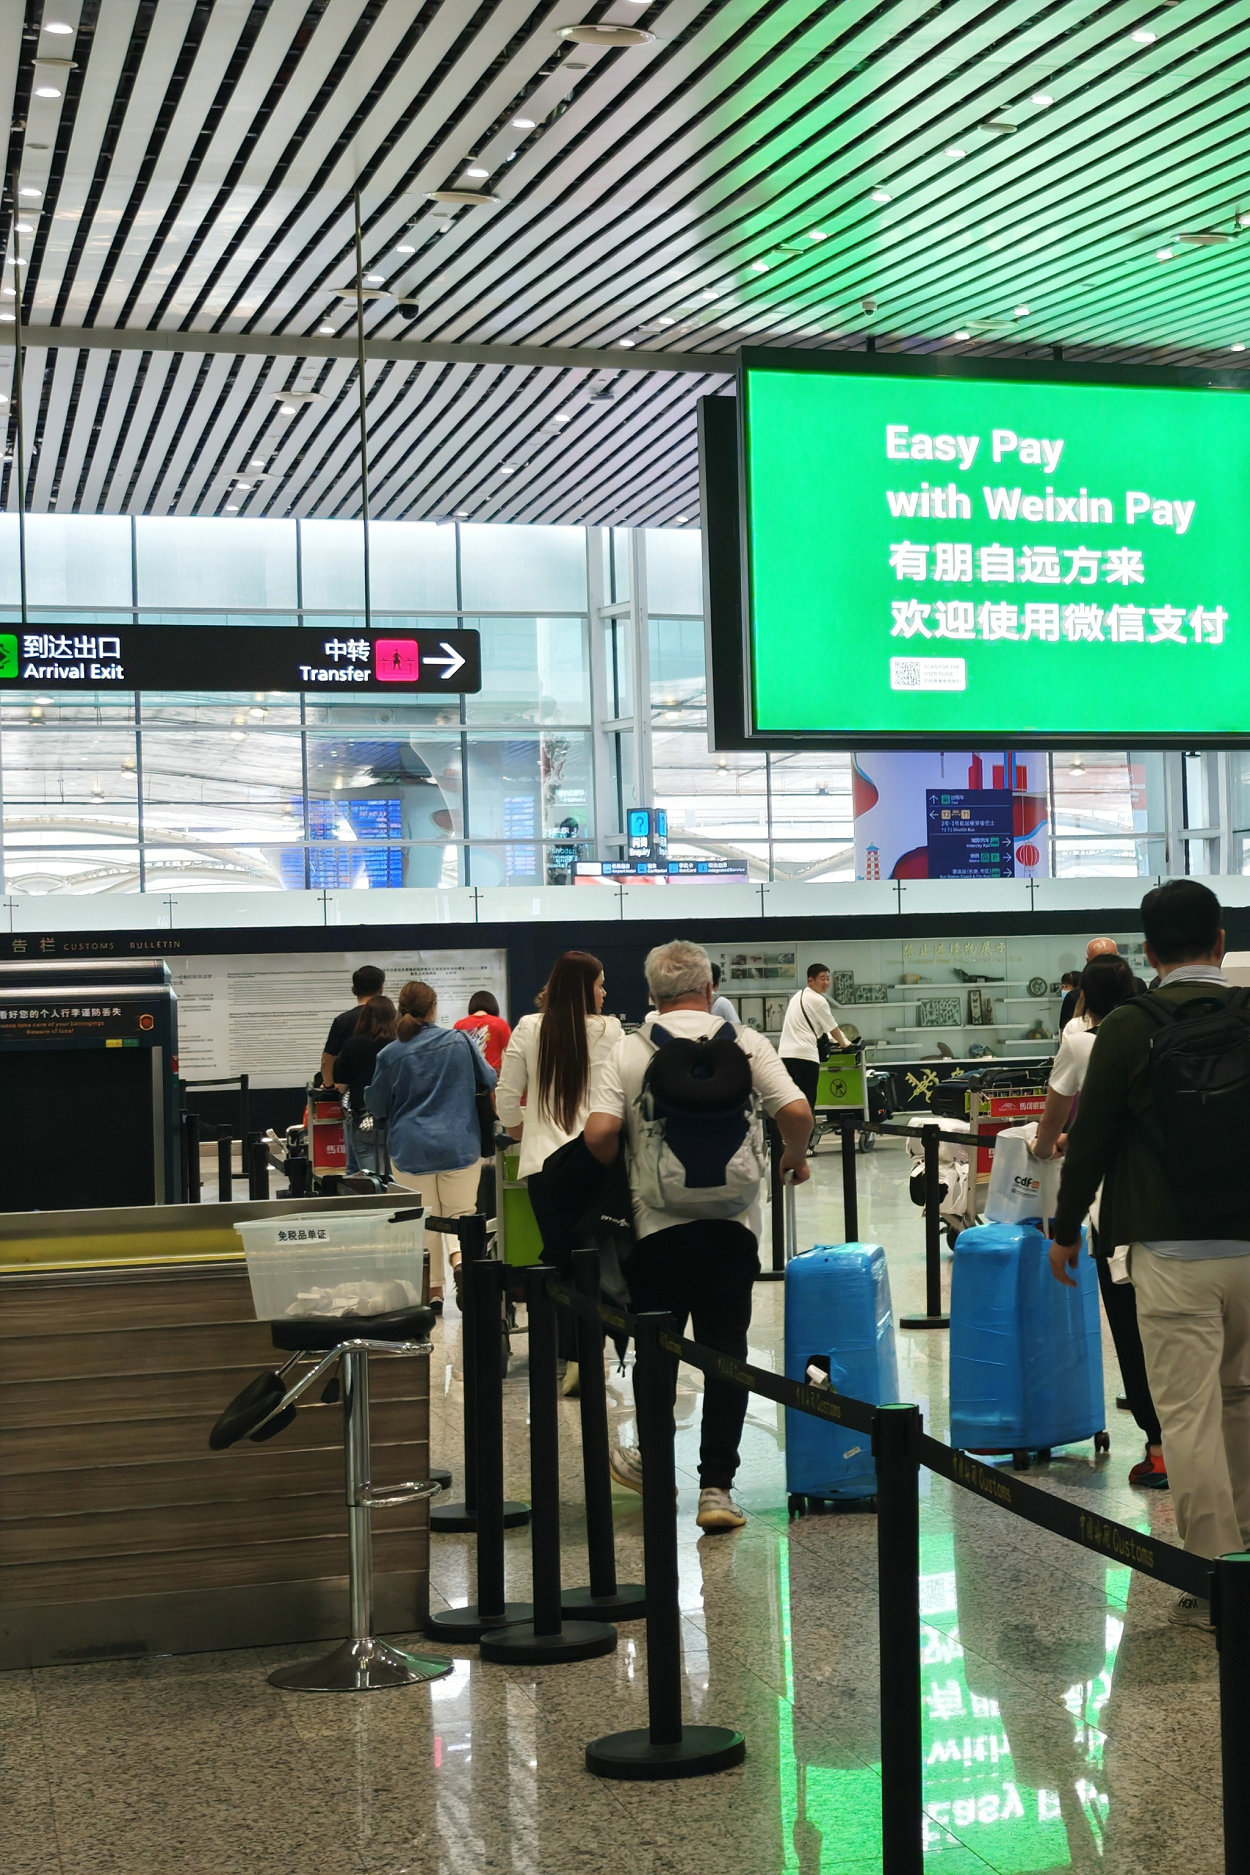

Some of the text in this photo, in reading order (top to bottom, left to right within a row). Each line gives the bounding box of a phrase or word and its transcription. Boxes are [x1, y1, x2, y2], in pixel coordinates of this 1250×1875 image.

[886, 425, 1064, 472] Easy Pay
[887, 483, 1196, 534] with Weixin Pay
[889, 541, 1145, 586] 有朋自远方来
[890, 599, 1229, 645] 欢迎使用微信支付
[23, 635, 122, 661] 到达出口
[325, 639, 371, 662] 中转
[24, 663, 125, 681] Arrival Exit
[300, 666, 372, 683] Transfer
[63, 940, 181, 951] CUSTOMS BULLETIN
[1014, 1175, 1033, 1187] cdf
[278, 1229, 327, 1241] 免税品单证
[1112, 1528, 1154, 1569] Customs
